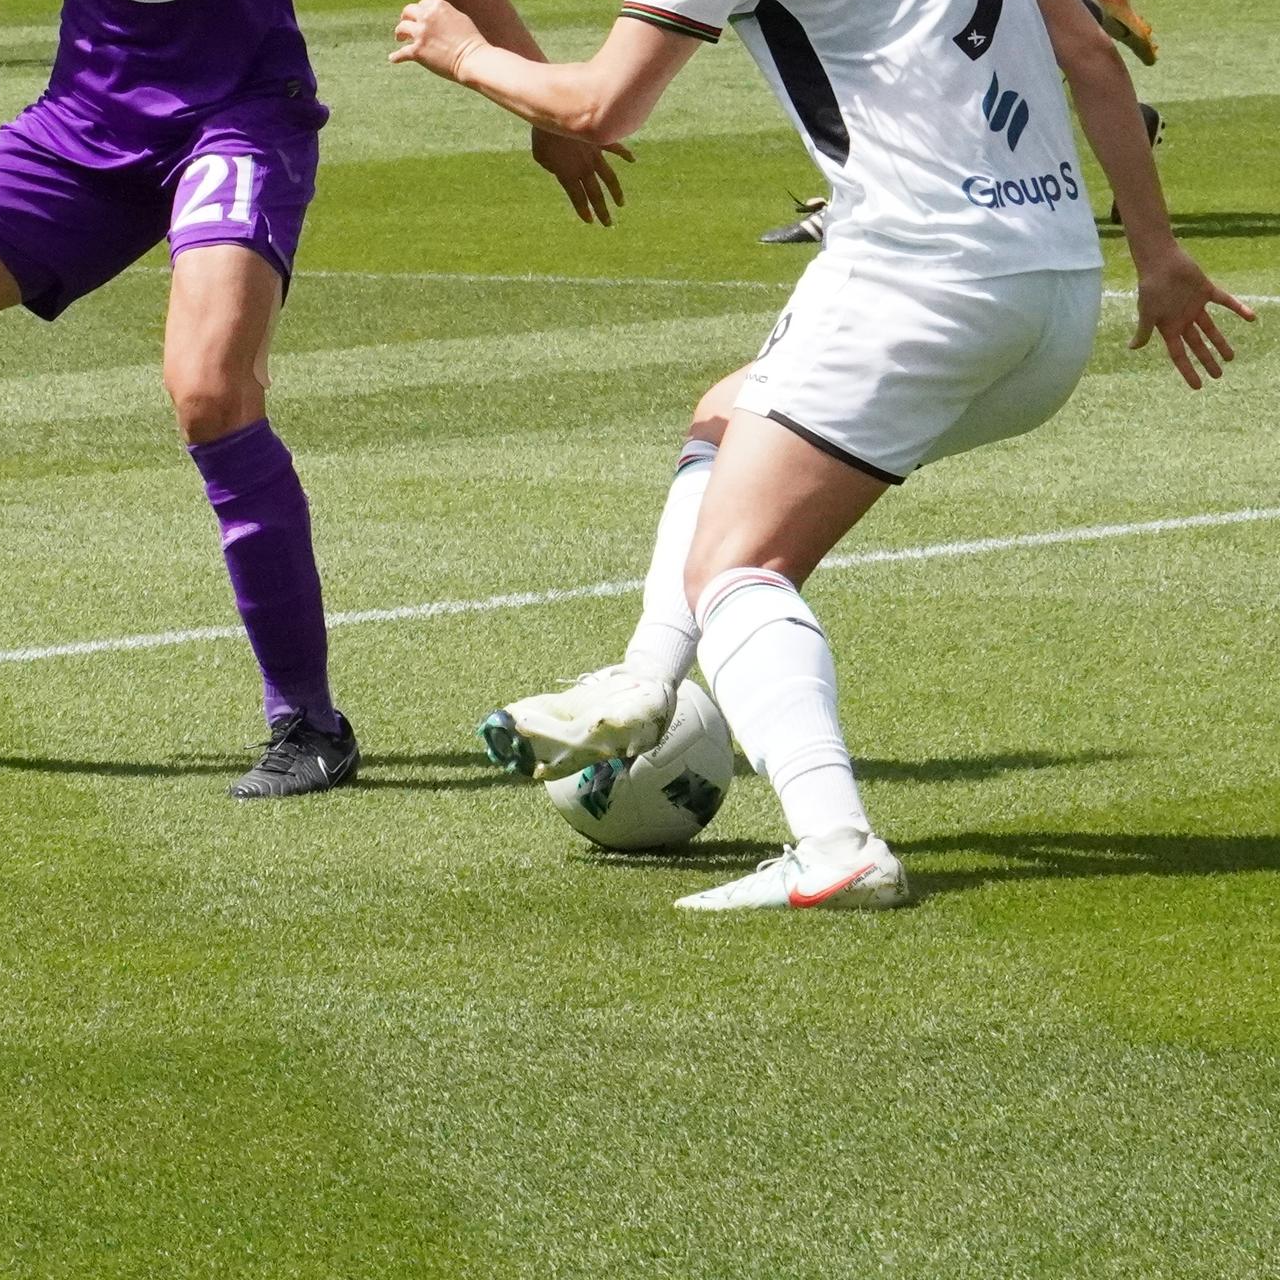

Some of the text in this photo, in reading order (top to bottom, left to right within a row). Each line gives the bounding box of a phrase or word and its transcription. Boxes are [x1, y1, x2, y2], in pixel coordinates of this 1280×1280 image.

[171, 153, 255, 233] 21
[961, 161, 1079, 212] Group S
